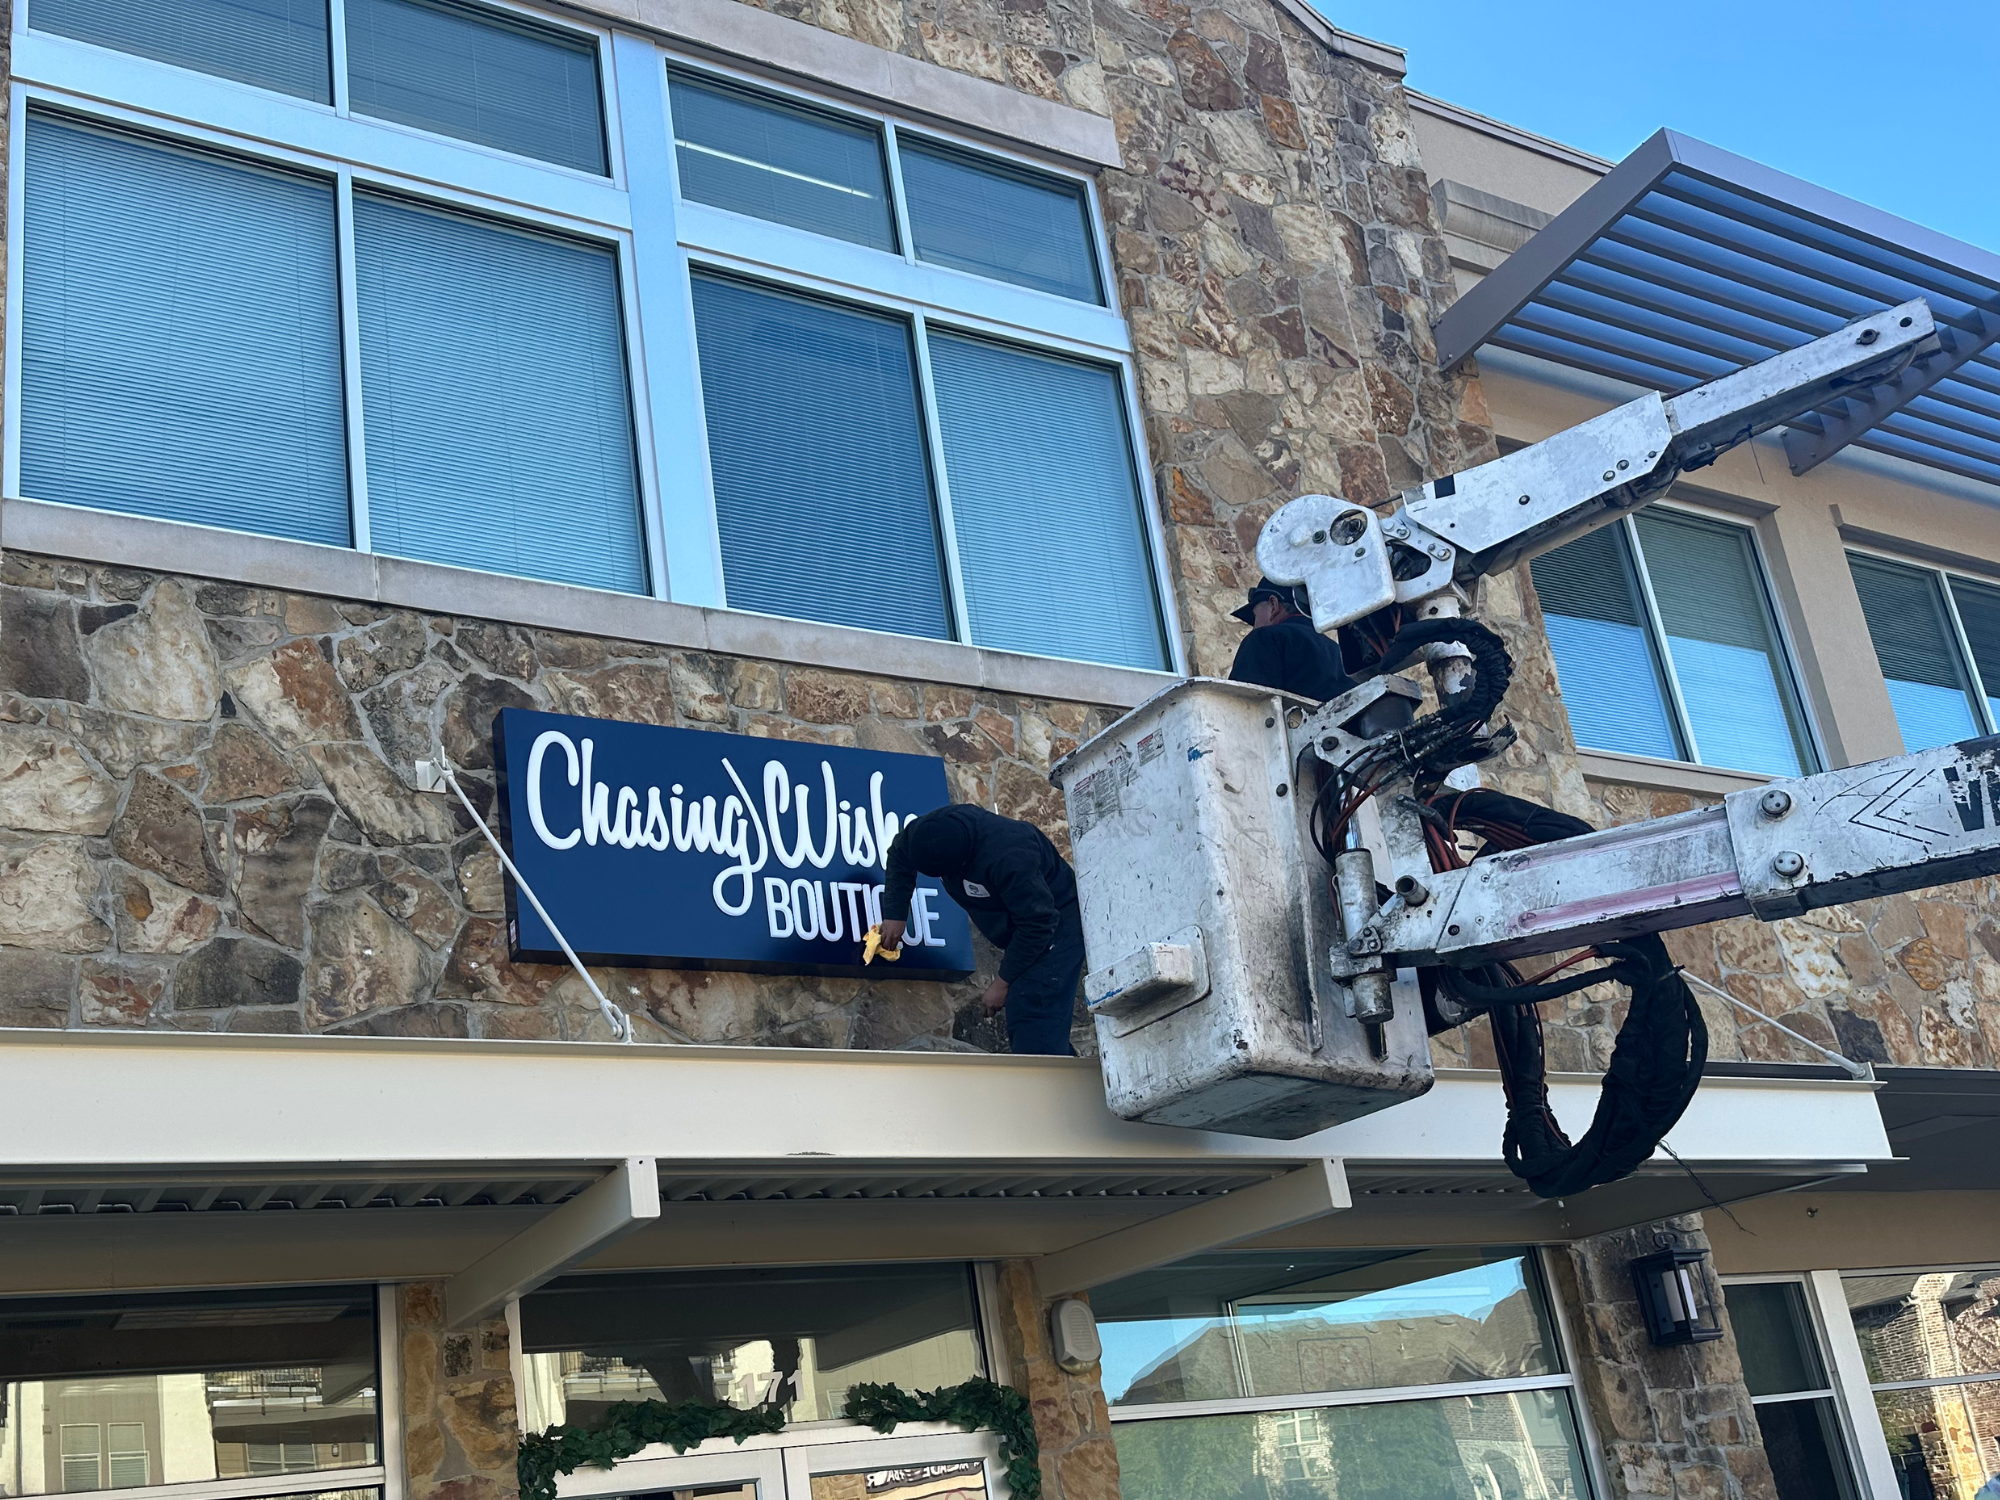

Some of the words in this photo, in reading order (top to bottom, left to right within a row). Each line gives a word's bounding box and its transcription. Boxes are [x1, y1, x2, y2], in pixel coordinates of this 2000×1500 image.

[527, 730, 768, 916] Chasing
[763, 760, 919, 871] Wish
[738, 1370, 804, 1404] 171
